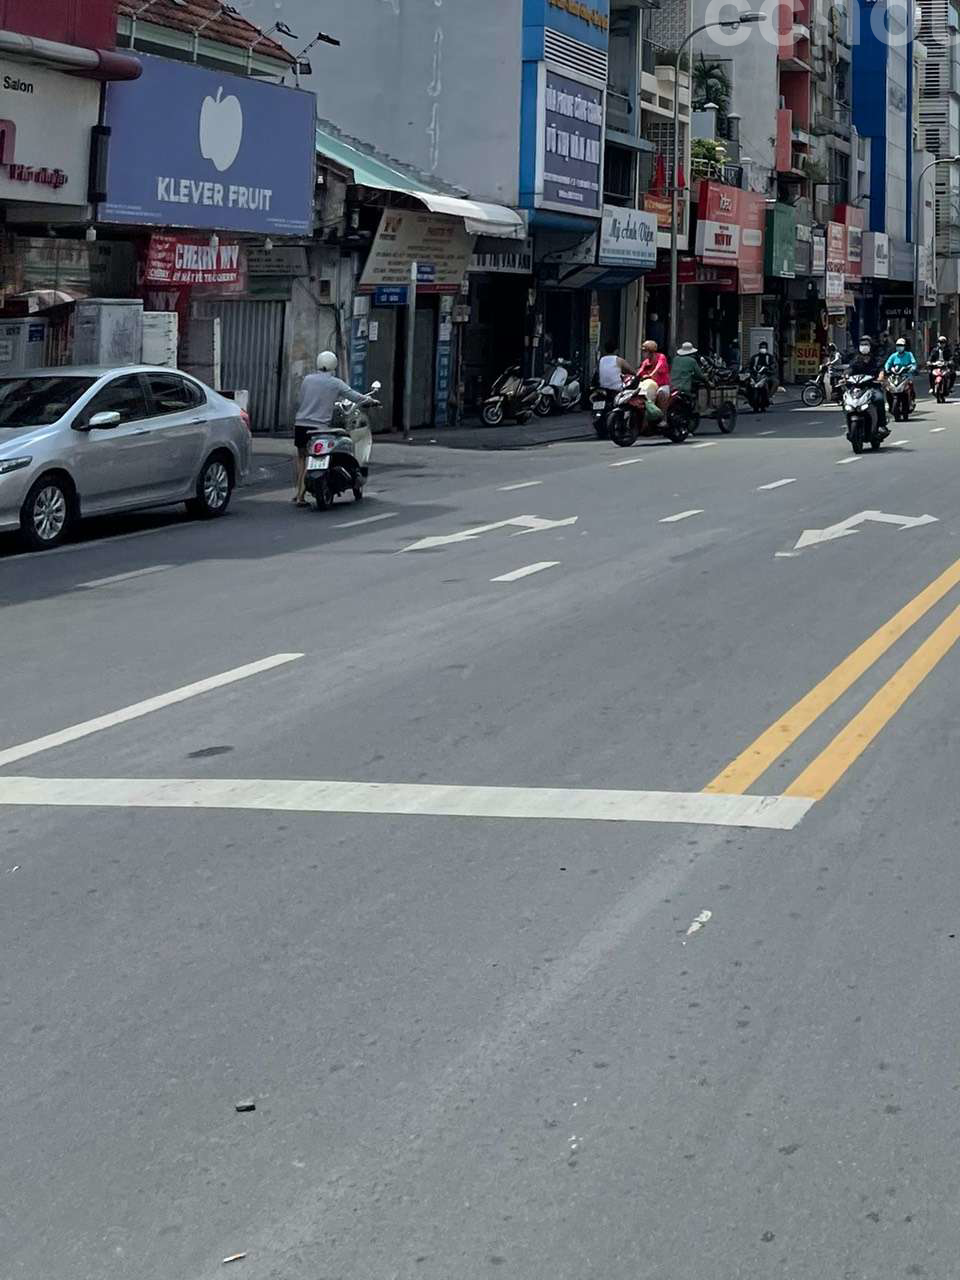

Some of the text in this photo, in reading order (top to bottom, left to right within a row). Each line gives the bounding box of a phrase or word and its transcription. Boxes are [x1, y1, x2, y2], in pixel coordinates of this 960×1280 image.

[3, 76, 34, 94] Salon
[157, 176, 273, 211] KLEVER FRUIT
